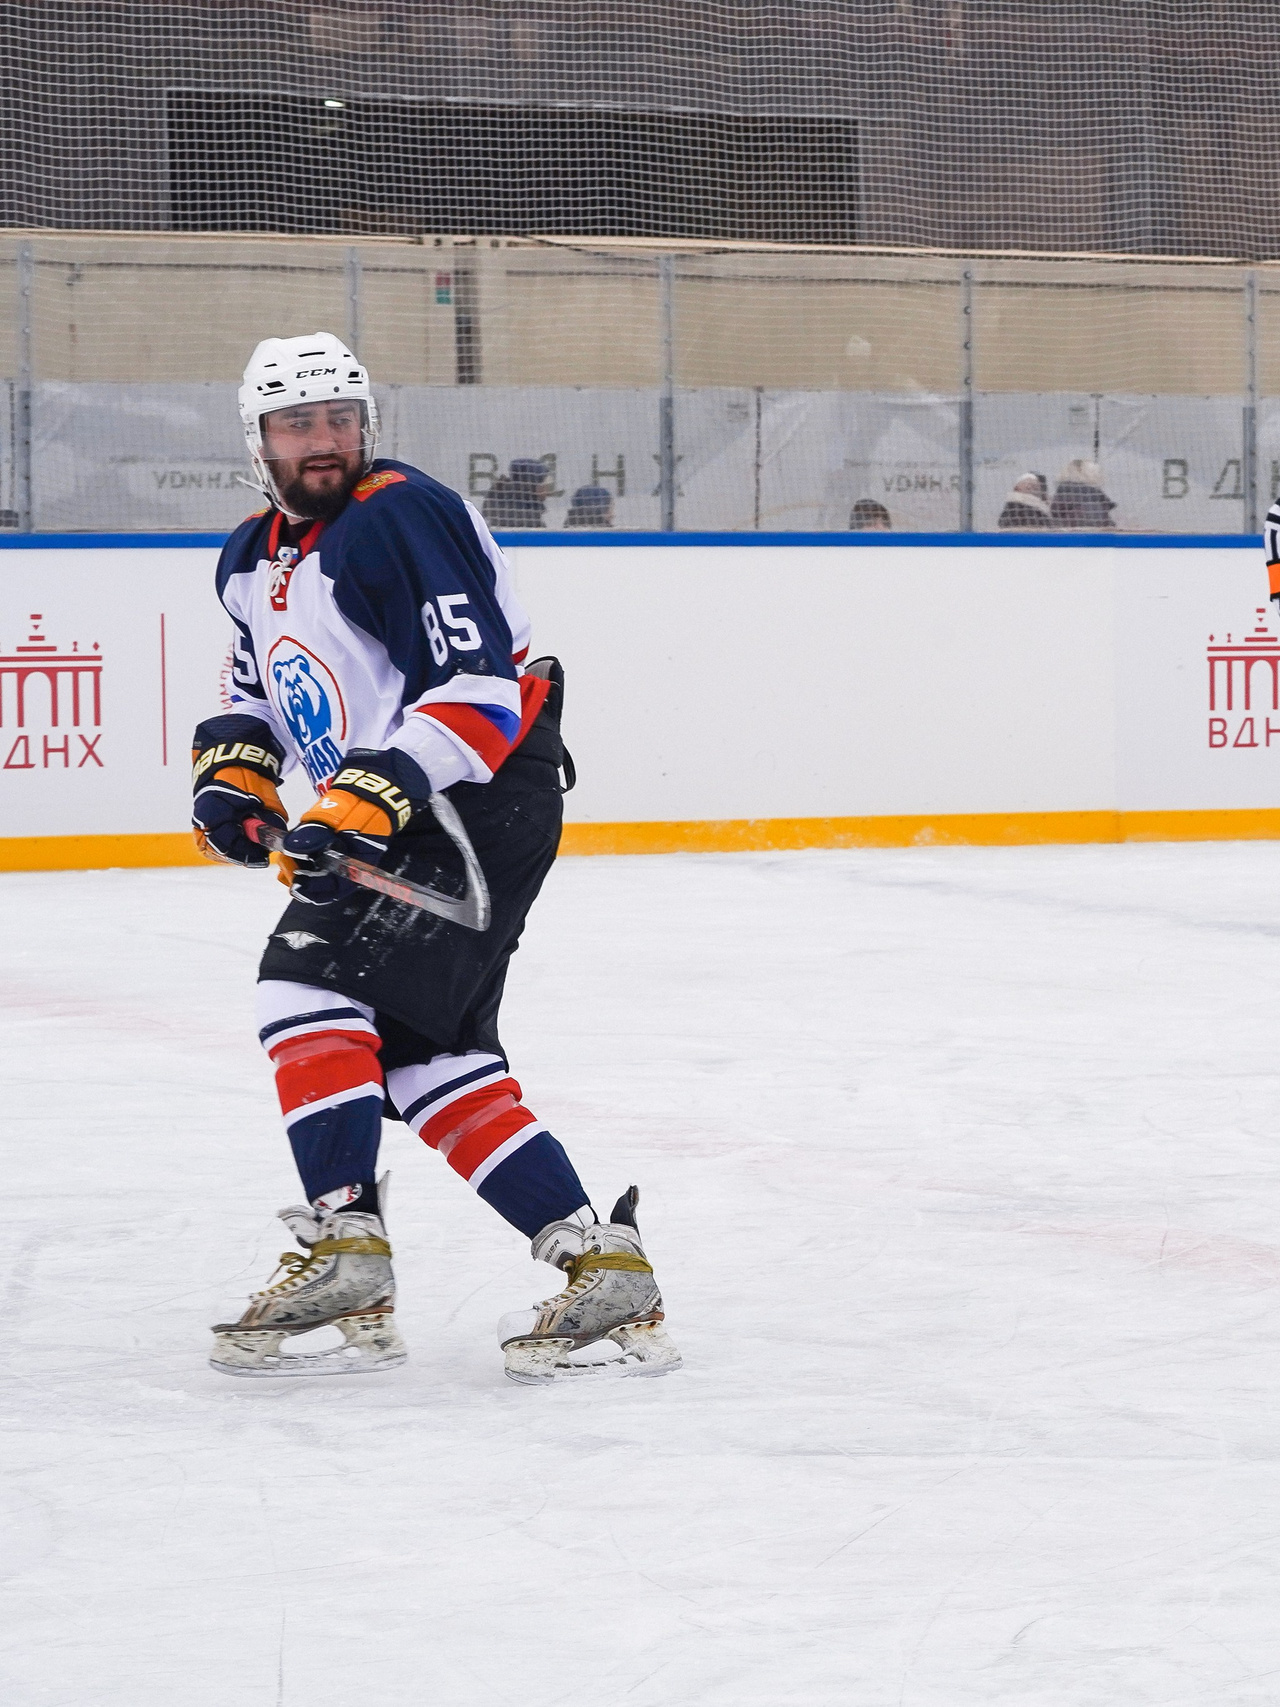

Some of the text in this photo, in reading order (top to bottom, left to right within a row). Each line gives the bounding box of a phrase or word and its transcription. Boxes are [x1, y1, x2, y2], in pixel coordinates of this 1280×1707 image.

[296, 367, 338, 379] CCM
[233, 618, 259, 685] 5
[421, 593, 483, 667] 85
[2, 733, 105, 770] ДНХ
